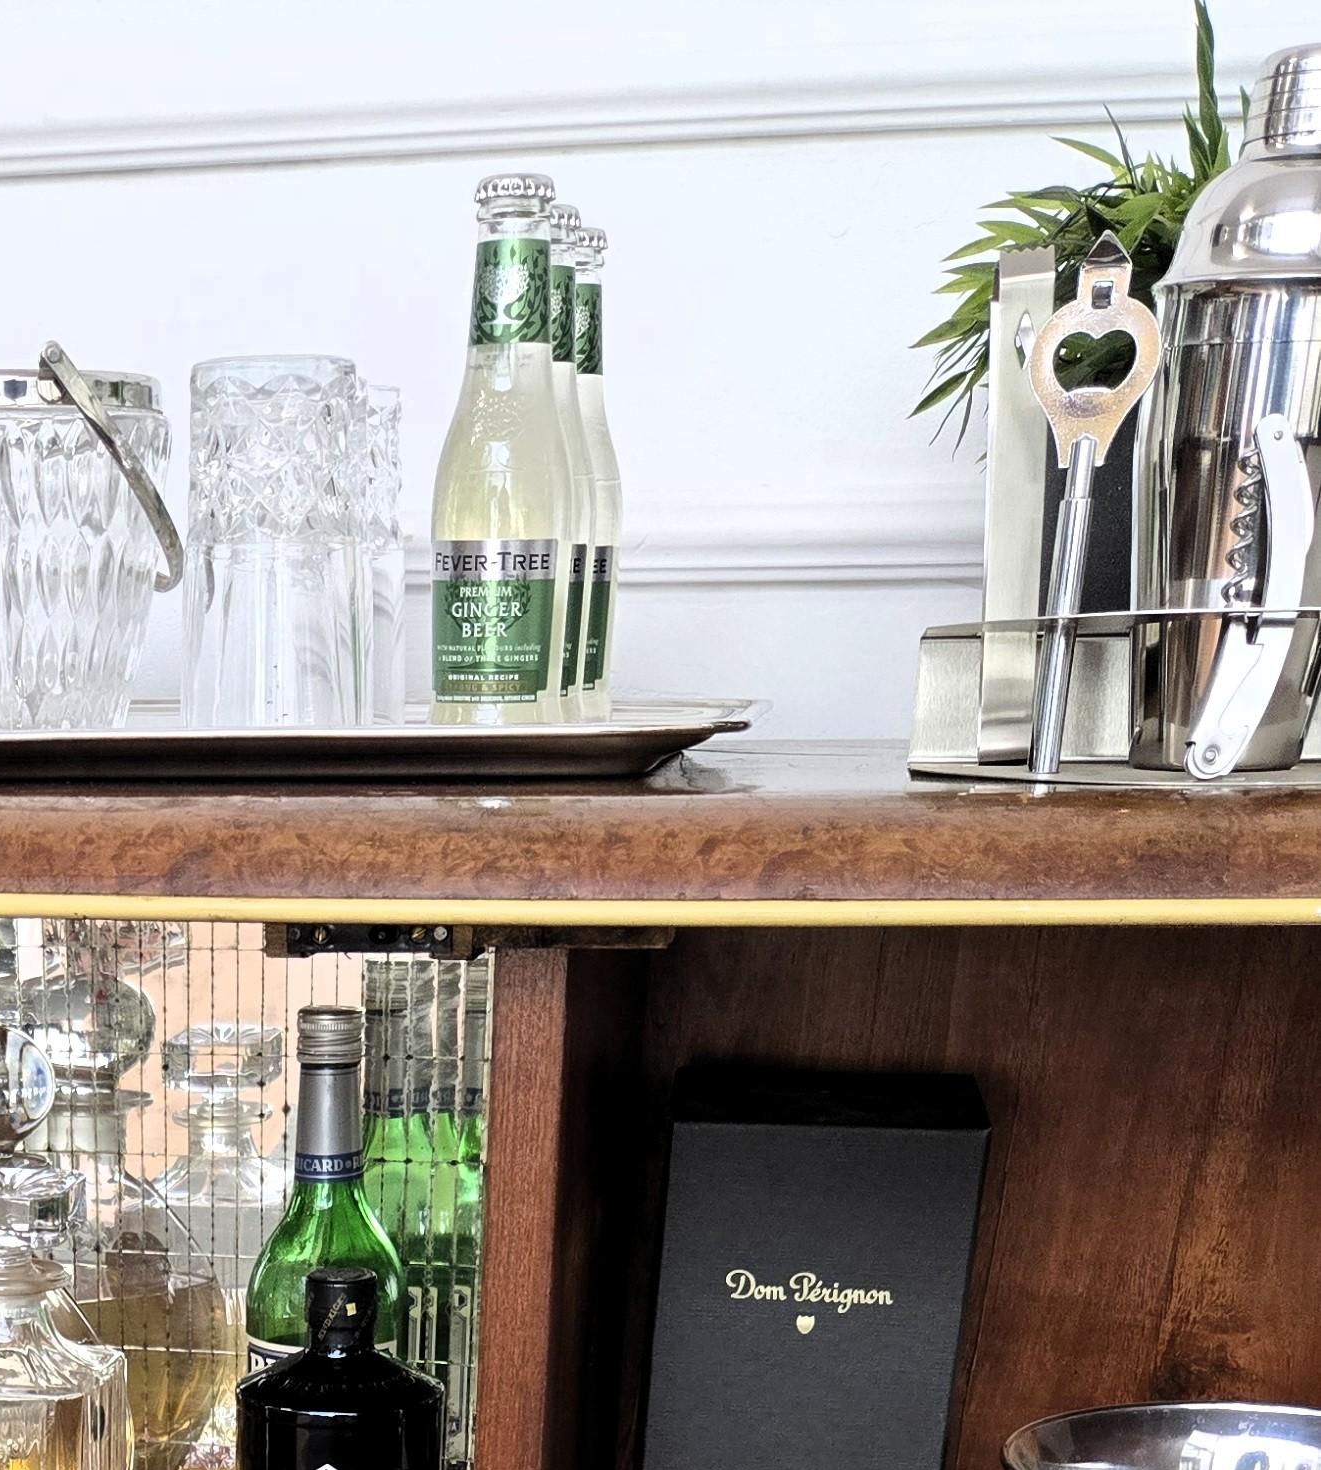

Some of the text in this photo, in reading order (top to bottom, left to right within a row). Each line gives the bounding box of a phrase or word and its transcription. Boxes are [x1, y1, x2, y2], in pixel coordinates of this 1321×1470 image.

[435, 551, 551, 572] FEVER-TREE
[459, 586, 513, 598] PREMUM
[451, 602, 523, 618] GINGER
[461, 623, 508, 639] BEER
[447, 674, 520, 682] ORIGINAL RECIPE
[725, 1269, 894, 1314] Dom Pérignon
